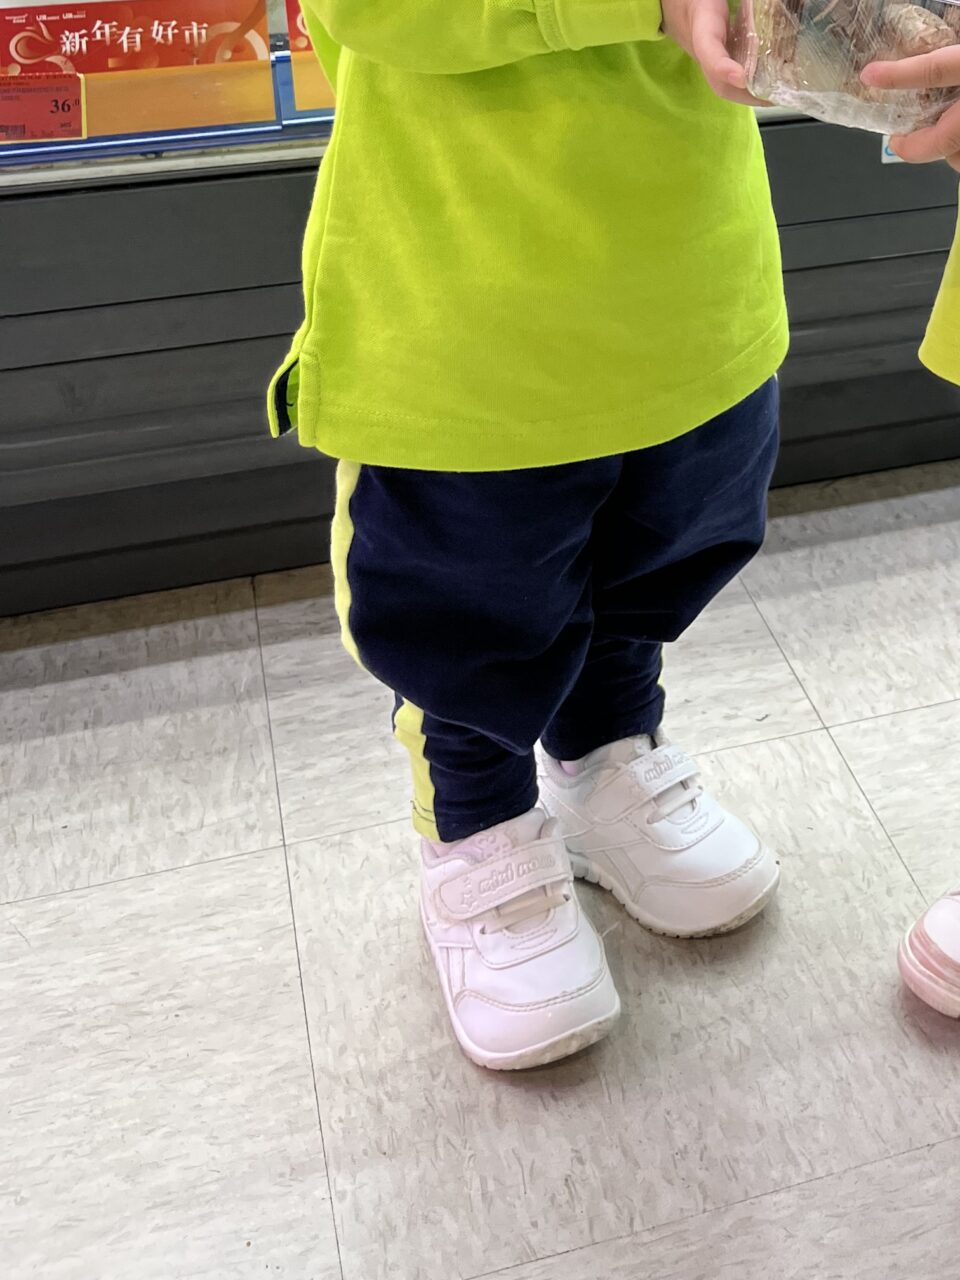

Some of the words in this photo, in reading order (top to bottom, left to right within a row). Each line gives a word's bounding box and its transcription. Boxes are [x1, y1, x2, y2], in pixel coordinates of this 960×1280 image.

[59, 19, 209, 56] 新年有好市
